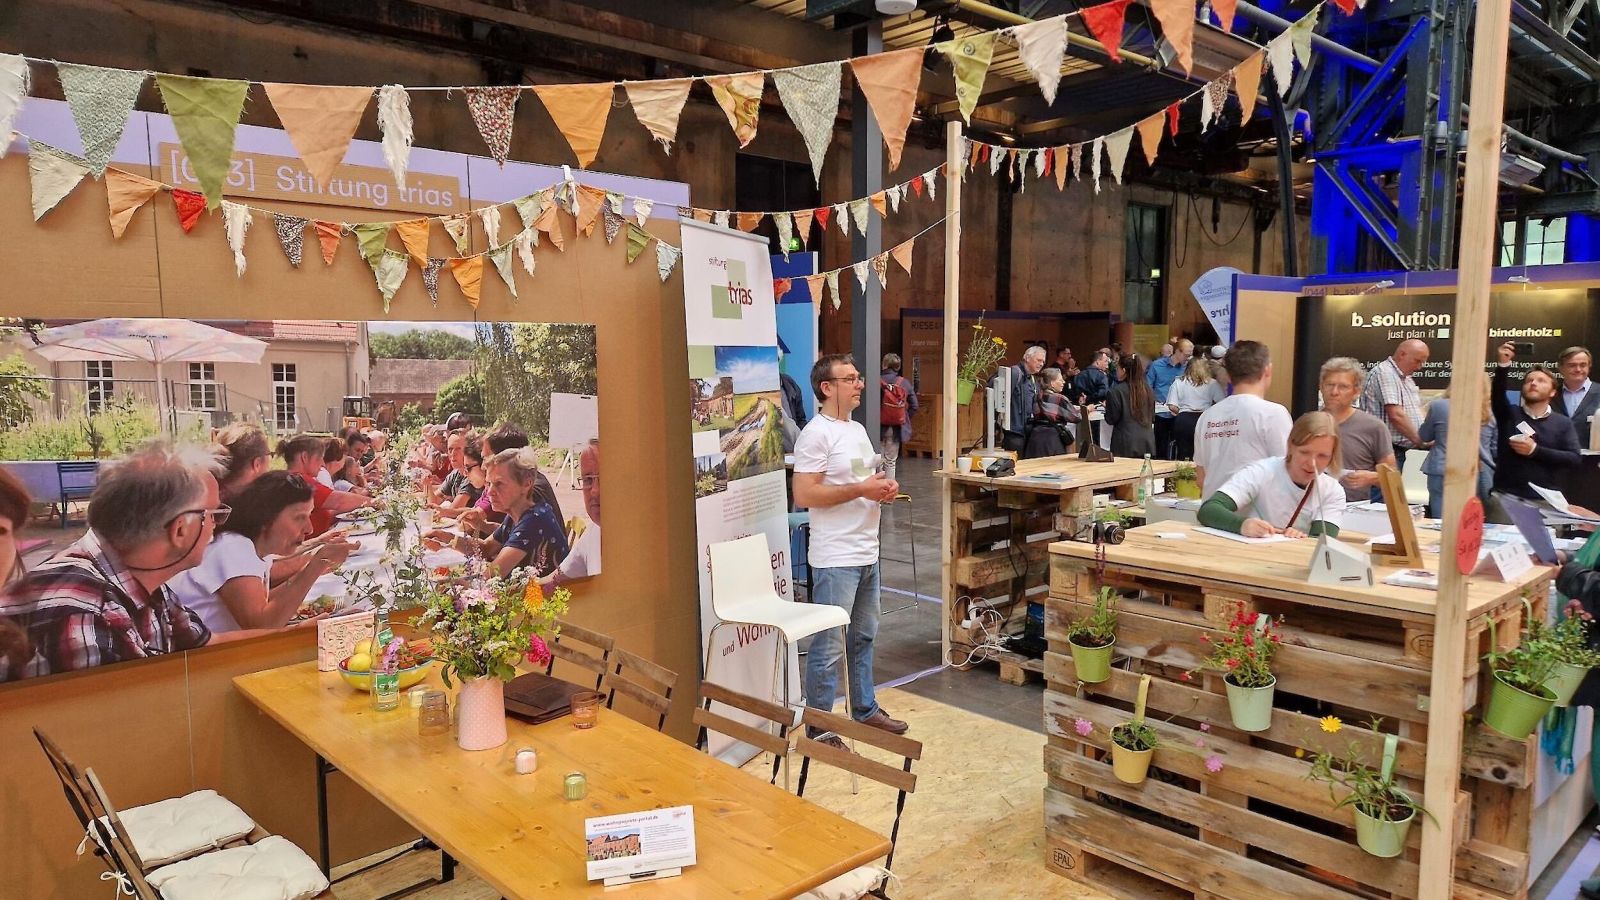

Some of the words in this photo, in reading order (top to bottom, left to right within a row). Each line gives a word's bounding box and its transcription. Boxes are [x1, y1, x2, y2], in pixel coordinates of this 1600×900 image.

[171, 150, 255, 192] [03]
[398, 180, 453, 208] trias
[727, 281, 753, 305] trias
[1351, 311, 1451, 328] b_solution
[1387, 330, 1404, 341] just
[1406, 330, 1426, 340] plan
[1428, 329, 1435, 338] it
[1489, 327, 1552, 338] binderholz
[1424, 370, 1437, 378] für
[722, 640, 735, 657] und
[1053, 850, 1071, 867] EPAL
